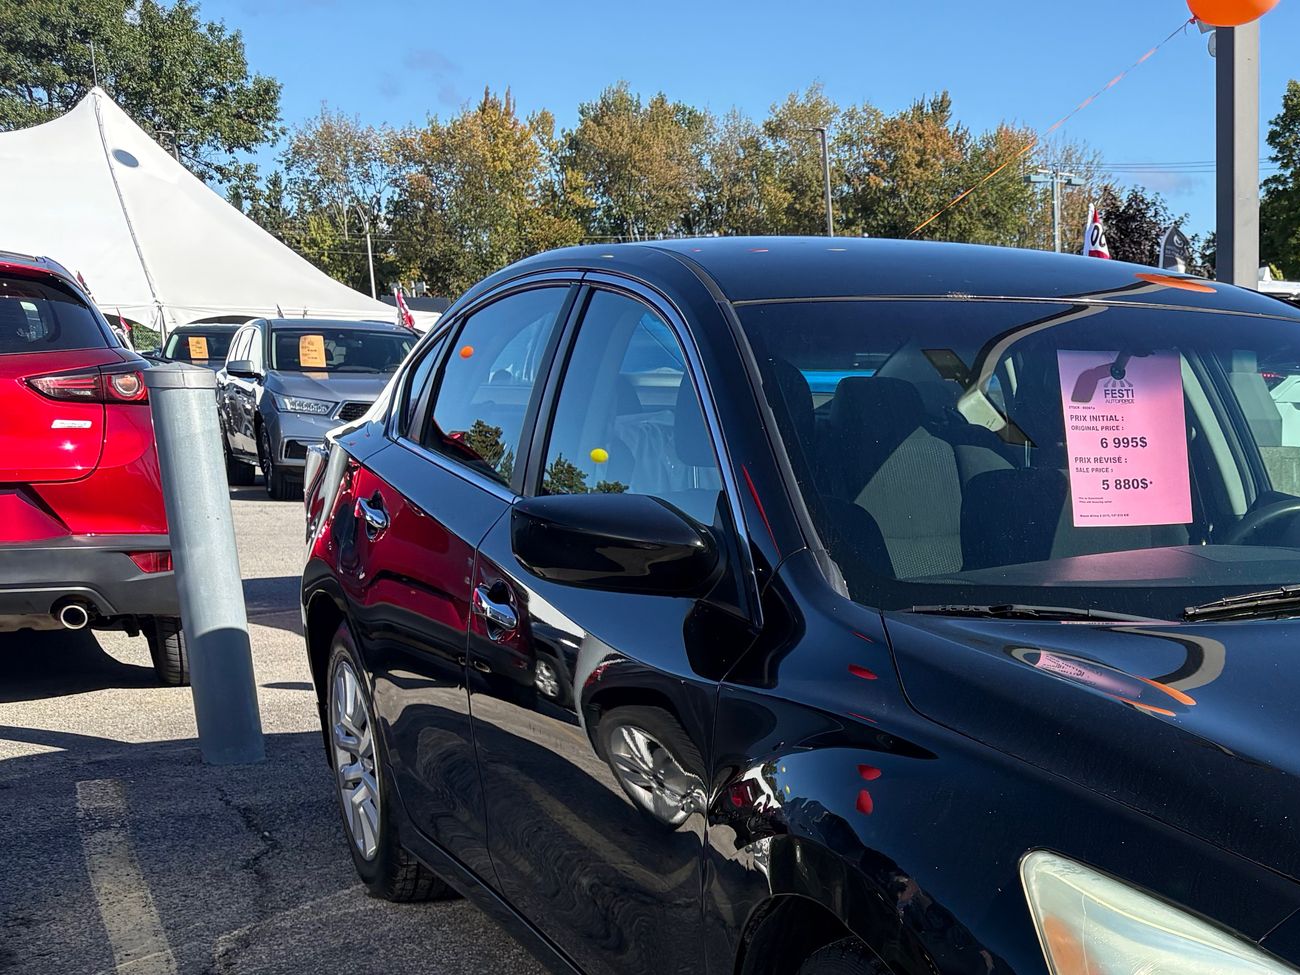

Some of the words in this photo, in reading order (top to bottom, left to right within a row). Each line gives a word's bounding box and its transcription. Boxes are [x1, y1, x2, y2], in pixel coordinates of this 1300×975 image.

[1103, 388, 1135, 399] FESTI
[1070, 414, 1088, 422] PRIX
[1089, 414, 1119, 422] INITIAL
[1100, 437, 1108, 449] 6
[1112, 436, 1148, 449] 995$
[1074, 456, 1091, 464] PRIX
[1102, 479, 1110, 490] 5
